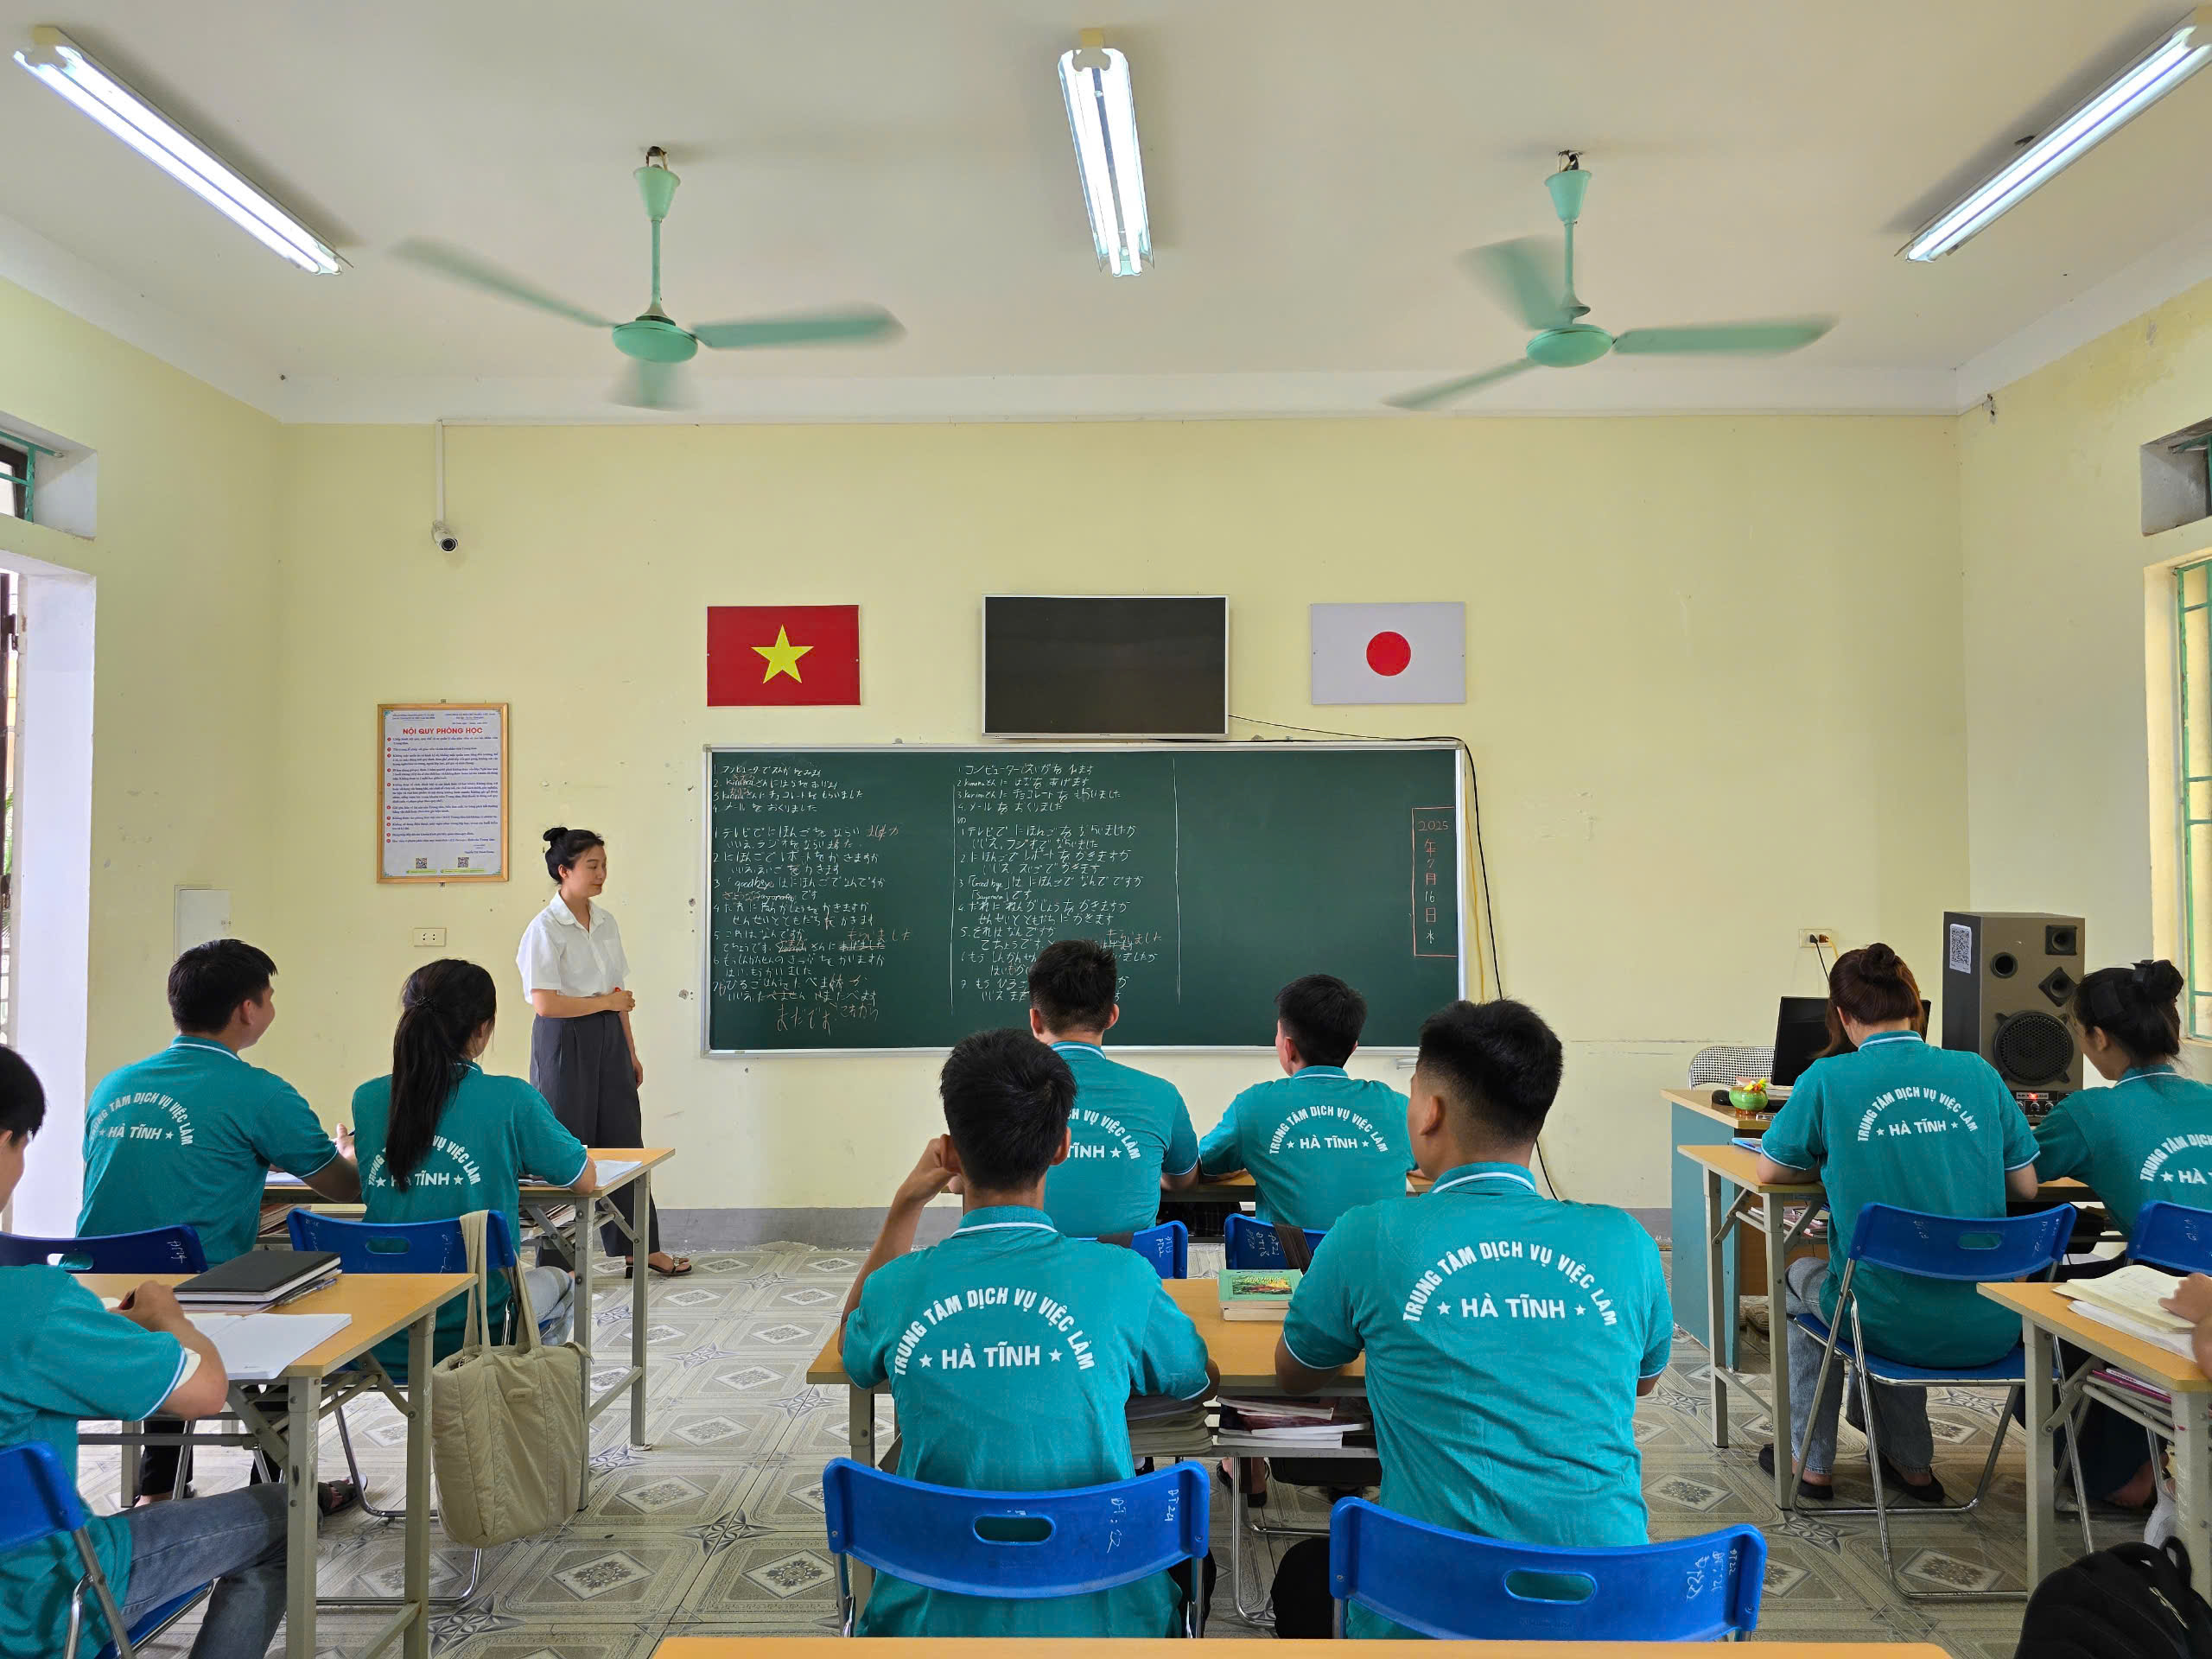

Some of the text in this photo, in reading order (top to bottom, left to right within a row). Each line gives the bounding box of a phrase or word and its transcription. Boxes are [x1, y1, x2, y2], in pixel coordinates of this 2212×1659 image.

[1418, 820, 1449, 831] 2025
[133, 1092, 161, 1104] DỊCH
[157, 1094, 174, 1109] VỤ
[168, 1102, 188, 1123] VIỆC
[179, 1122, 194, 1146] LÀM
[1858, 1086, 1979, 1141] TRUNG TÂM DỊCH VỤ VIỆC LÀM
[1889, 1118, 1947, 1136] HÀ TĨNH
[107, 1123, 162, 1140] HÀ TĨNH
[1084, 1109, 1100, 1126] VỤ
[1100, 1116, 1126, 1137] VIỆC
[1121, 1135, 1141, 1160] LÀM
[1269, 1105, 1389, 1154] TRUNG TÂM DỊCH VỤ VIỆC LÀM
[1300, 1134, 1358, 1149] HÀ TĨNH
[432, 1135, 448, 1152] VỤ
[446, 1141, 470, 1164] VIỆC
[462, 1160, 481, 1185] LÀM
[1067, 1141, 1105, 1158] TĨNH
[414, 1170, 450, 1186] TĨNH
[2139, 1148, 2169, 1182] TRUNG
[2177, 1167, 2208, 1185] HÀ
[1402, 1241, 1618, 1326] TRUNG TÂM DỊCH VỤ VIỆC LÀM
[1461, 1293, 1566, 1319] HÀ TĨNH
[894, 1287, 1096, 1376] TRUNG TÂM DỊCH VỤ VIỆC LÀM
[942, 1341, 1040, 1370] HÀ TĨNH
